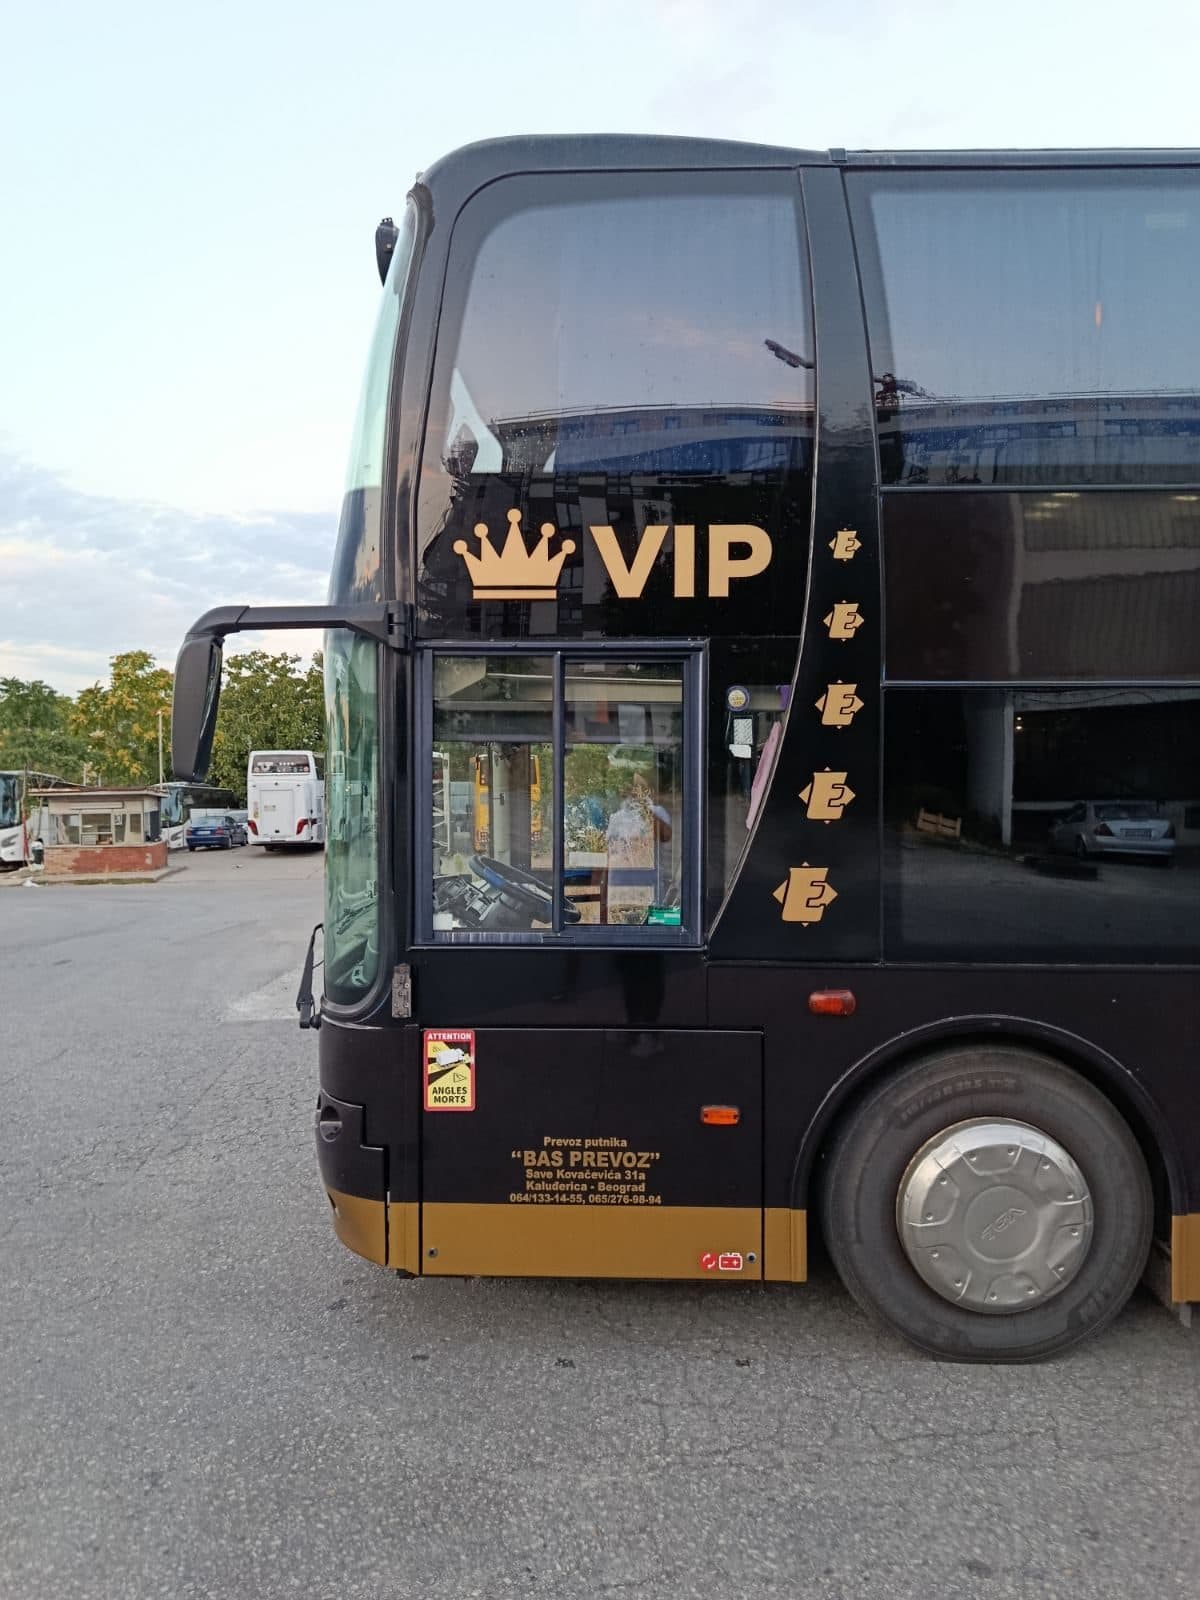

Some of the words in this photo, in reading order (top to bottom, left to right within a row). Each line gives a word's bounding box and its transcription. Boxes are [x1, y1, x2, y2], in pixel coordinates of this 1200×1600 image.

[588, 523, 773, 599] VIP
[427, 1032, 472, 1040] ATTENTION
[432, 1086, 468, 1095] ANGLES
[433, 1095, 466, 1104] MORTS
[543, 1136, 582, 1147] Prevoz
[584, 1137, 627, 1149] putnika
[526, 1169, 553, 1179] Save
[624, 1170, 646, 1180] 31a
[597, 1182, 646, 1194] Beograd
